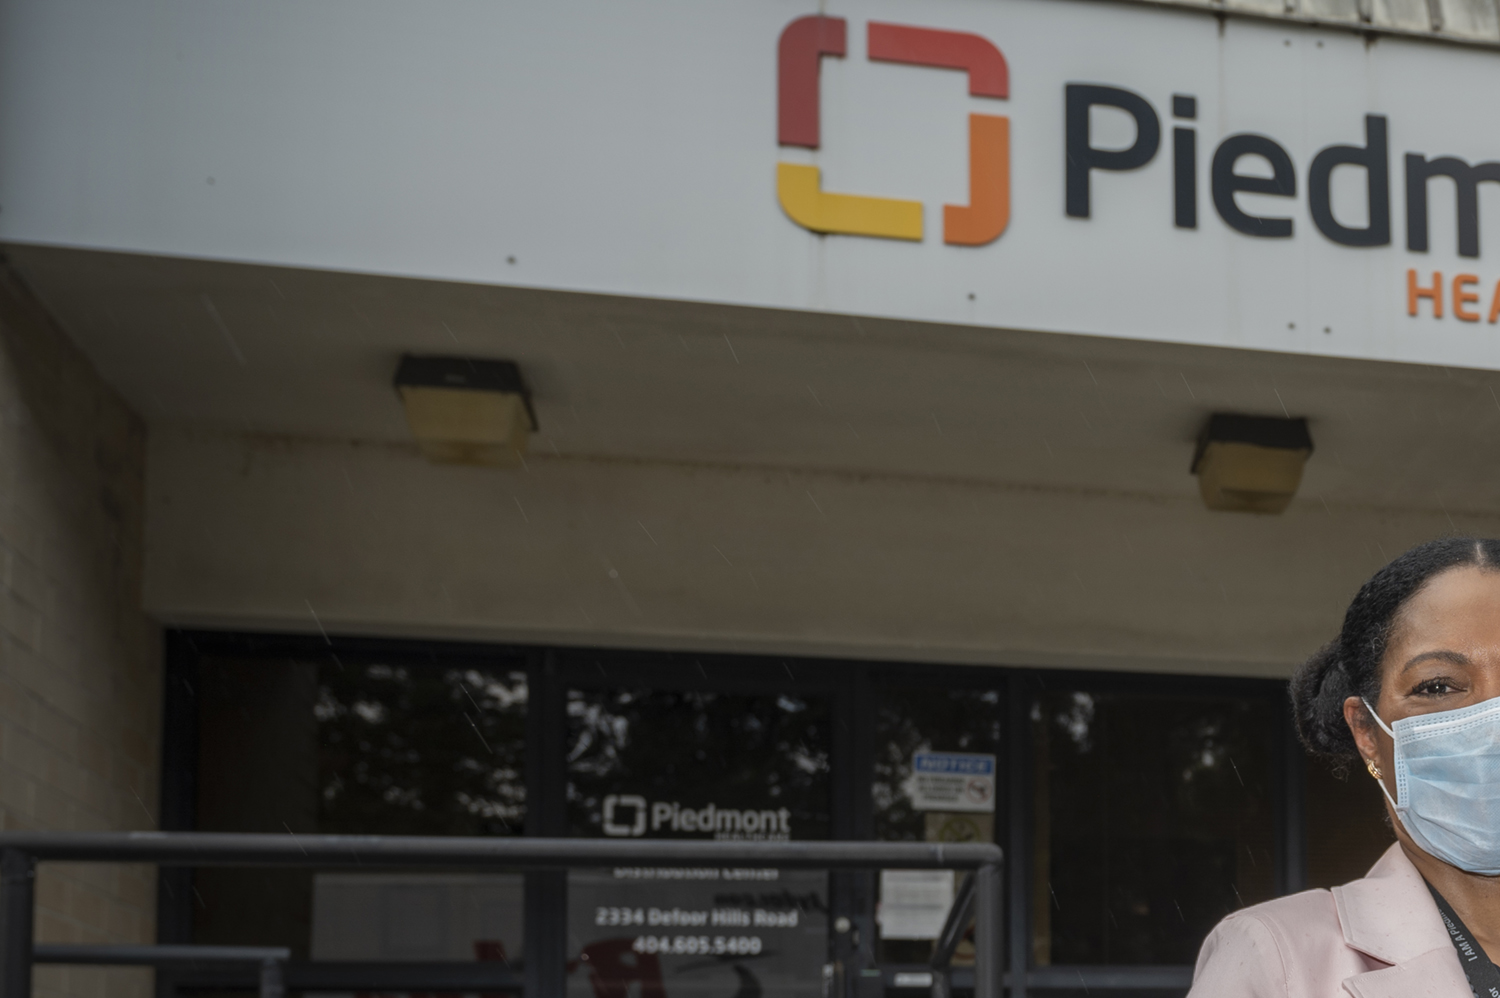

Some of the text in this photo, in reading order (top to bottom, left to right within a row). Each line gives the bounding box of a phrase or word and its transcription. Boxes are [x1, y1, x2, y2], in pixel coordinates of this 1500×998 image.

[652, 801, 791, 833] Piedmont
[596, 907, 645, 926] 2334
[711, 908, 750, 927] Hills
[754, 909, 799, 928] Road
[1455, 934, 1466, 942] A
[1459, 941, 1476, 956] AM
